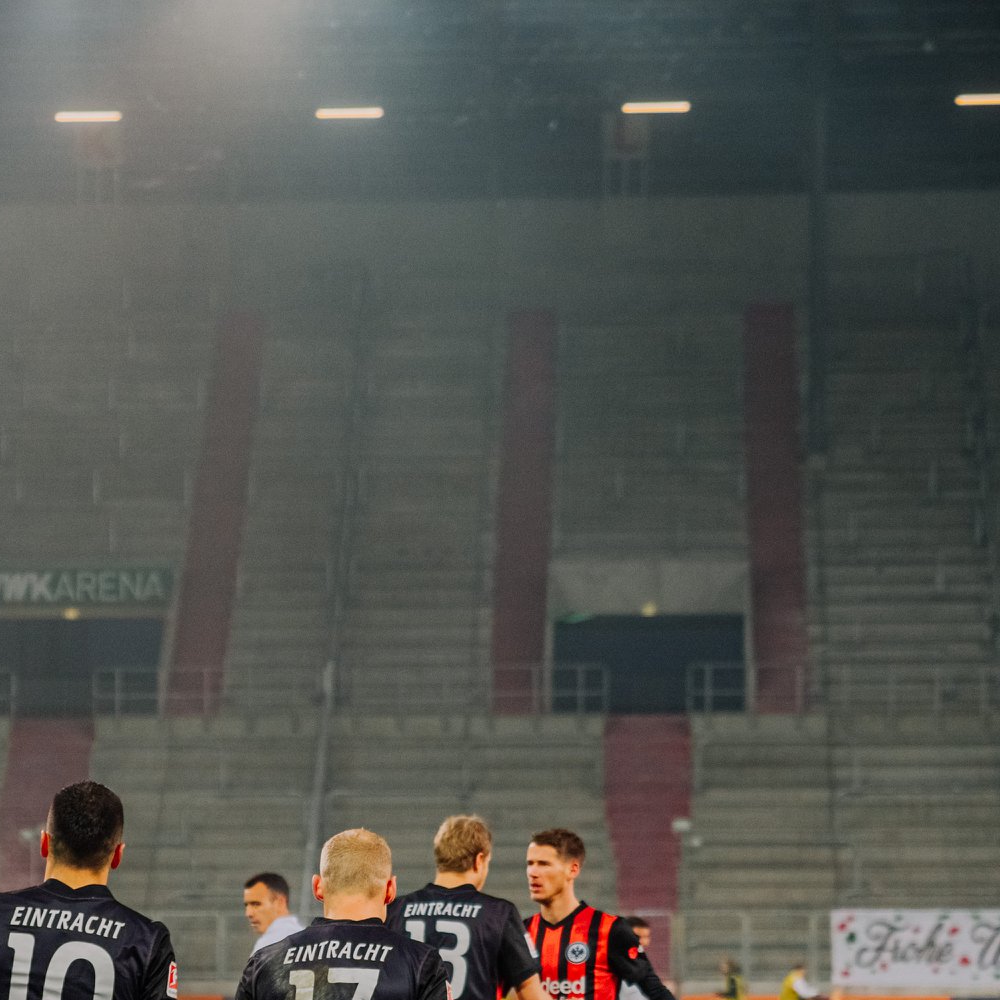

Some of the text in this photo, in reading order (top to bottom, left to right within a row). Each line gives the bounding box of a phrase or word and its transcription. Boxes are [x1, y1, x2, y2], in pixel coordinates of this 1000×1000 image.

[9, 905, 126, 939] EINTRACHT
[403, 902, 482, 918] EINTRACHT
[283, 940, 393, 965] EINTRACHT
[405, 920, 471, 1000] 3
[540, 976, 586, 995] deed
